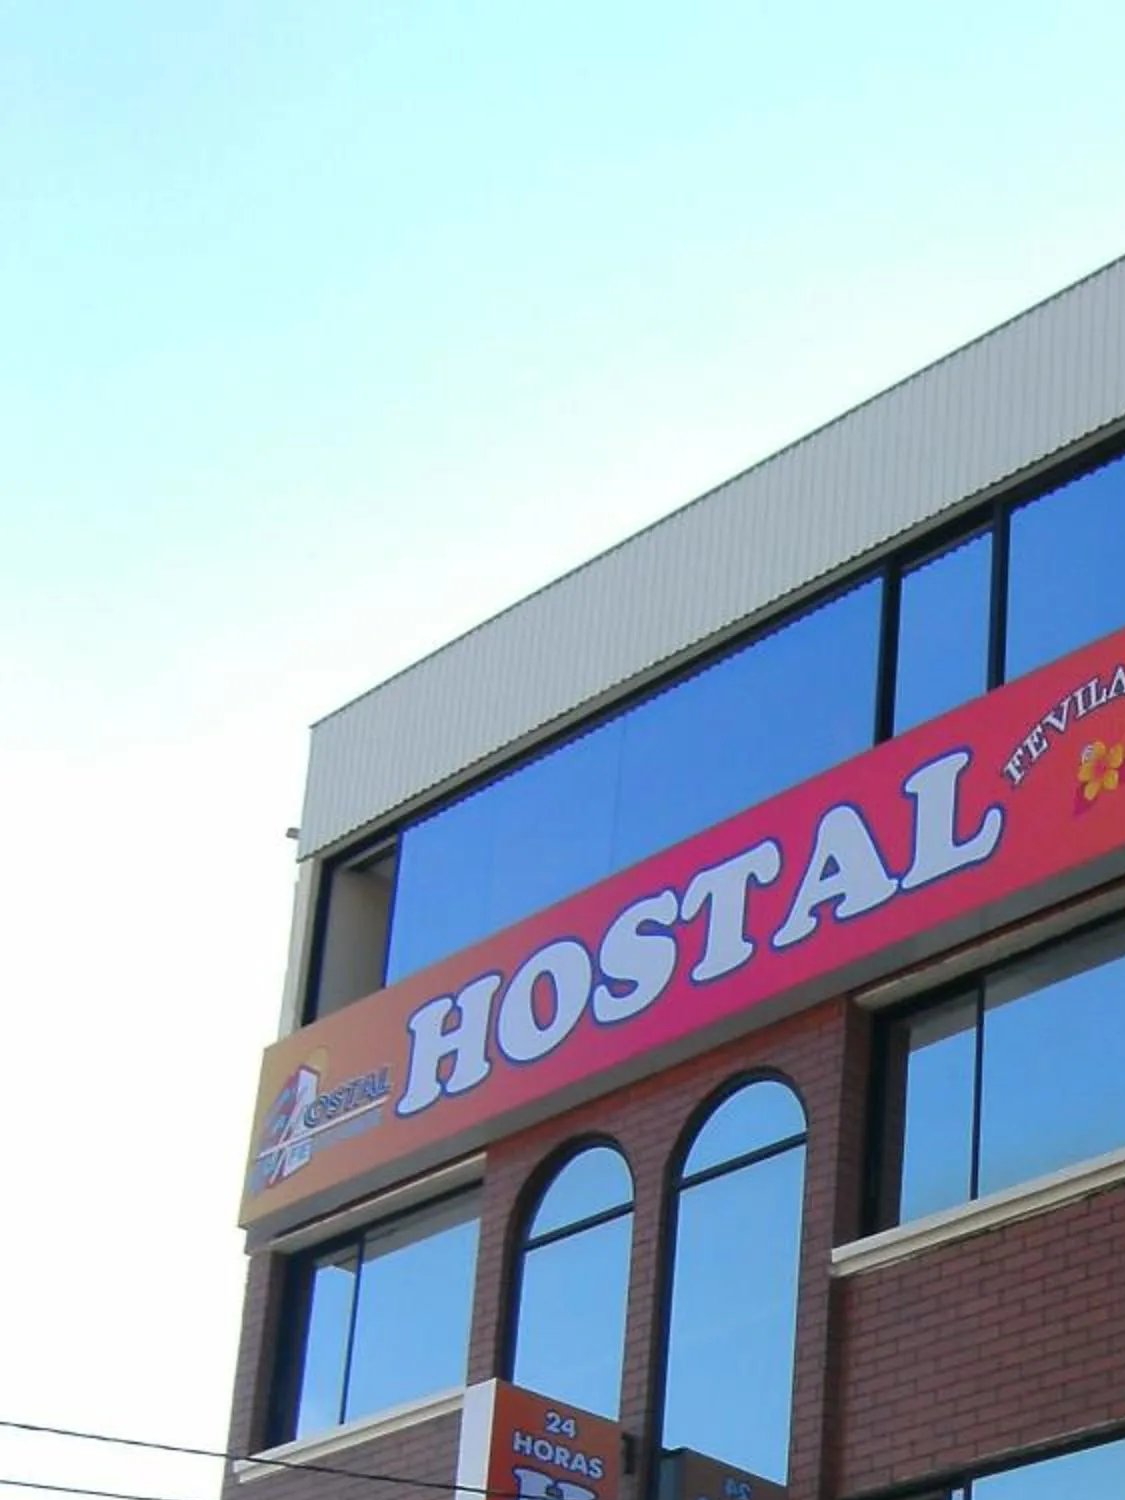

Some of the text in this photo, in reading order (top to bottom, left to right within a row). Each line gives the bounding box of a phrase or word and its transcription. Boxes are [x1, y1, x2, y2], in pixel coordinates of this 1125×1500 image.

[396, 747, 1003, 1119] HOSTAL
[546, 1410, 577, 1439] 24
[512, 1430, 604, 1480] HORAS
